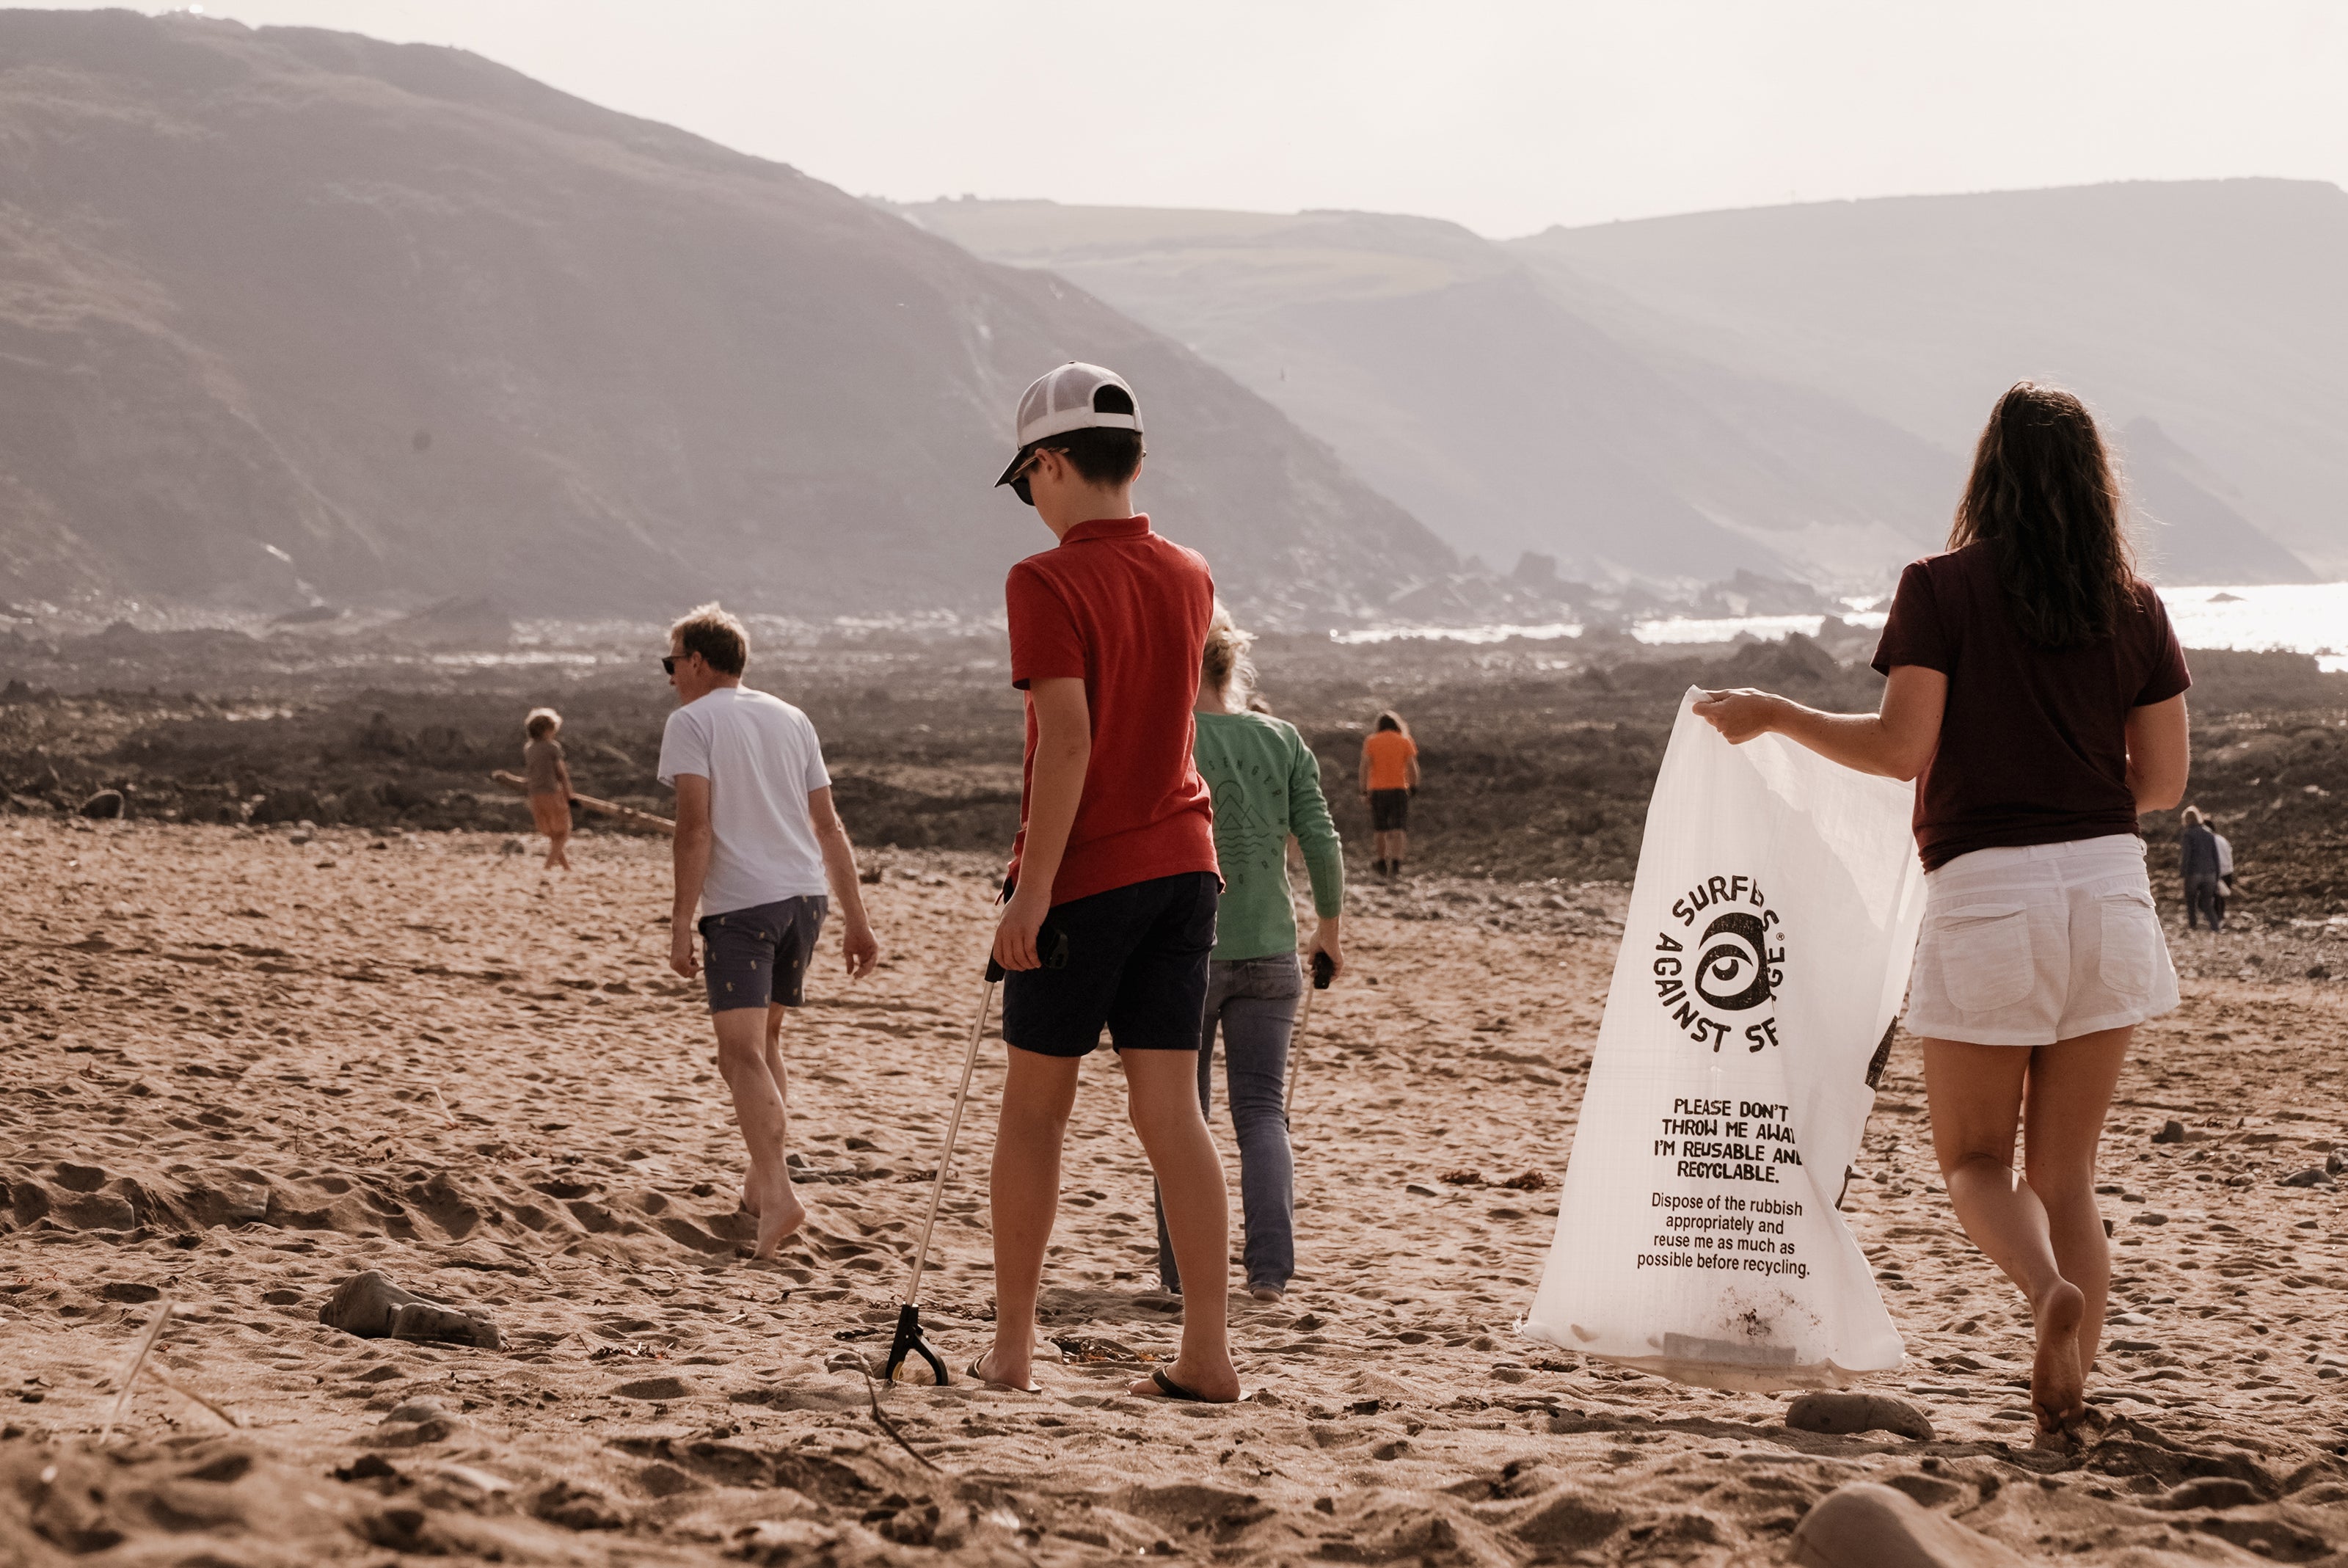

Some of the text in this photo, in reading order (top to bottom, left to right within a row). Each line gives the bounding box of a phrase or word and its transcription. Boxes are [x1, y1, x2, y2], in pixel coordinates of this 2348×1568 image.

[1653, 932, 1732, 1053] AGAINST
[1674, 1098, 1789, 1122] PLEASE DON'T
[1662, 1119, 1718, 1136] THROW
[1726, 1122, 1748, 1138] ME
[1655, 1140, 1675, 1156] I'M
[1683, 1141, 1765, 1161] REUSABLE
[1677, 1161, 1779, 1184] RECYCLABLE.
[1652, 1192, 1802, 1216] Dispose of the rubbish
[1666, 1215, 1784, 1235] appropriately and
[1654, 1234, 1795, 1255] reuse me as much as
[1637, 1252, 1810, 1279] possible before recycling.
